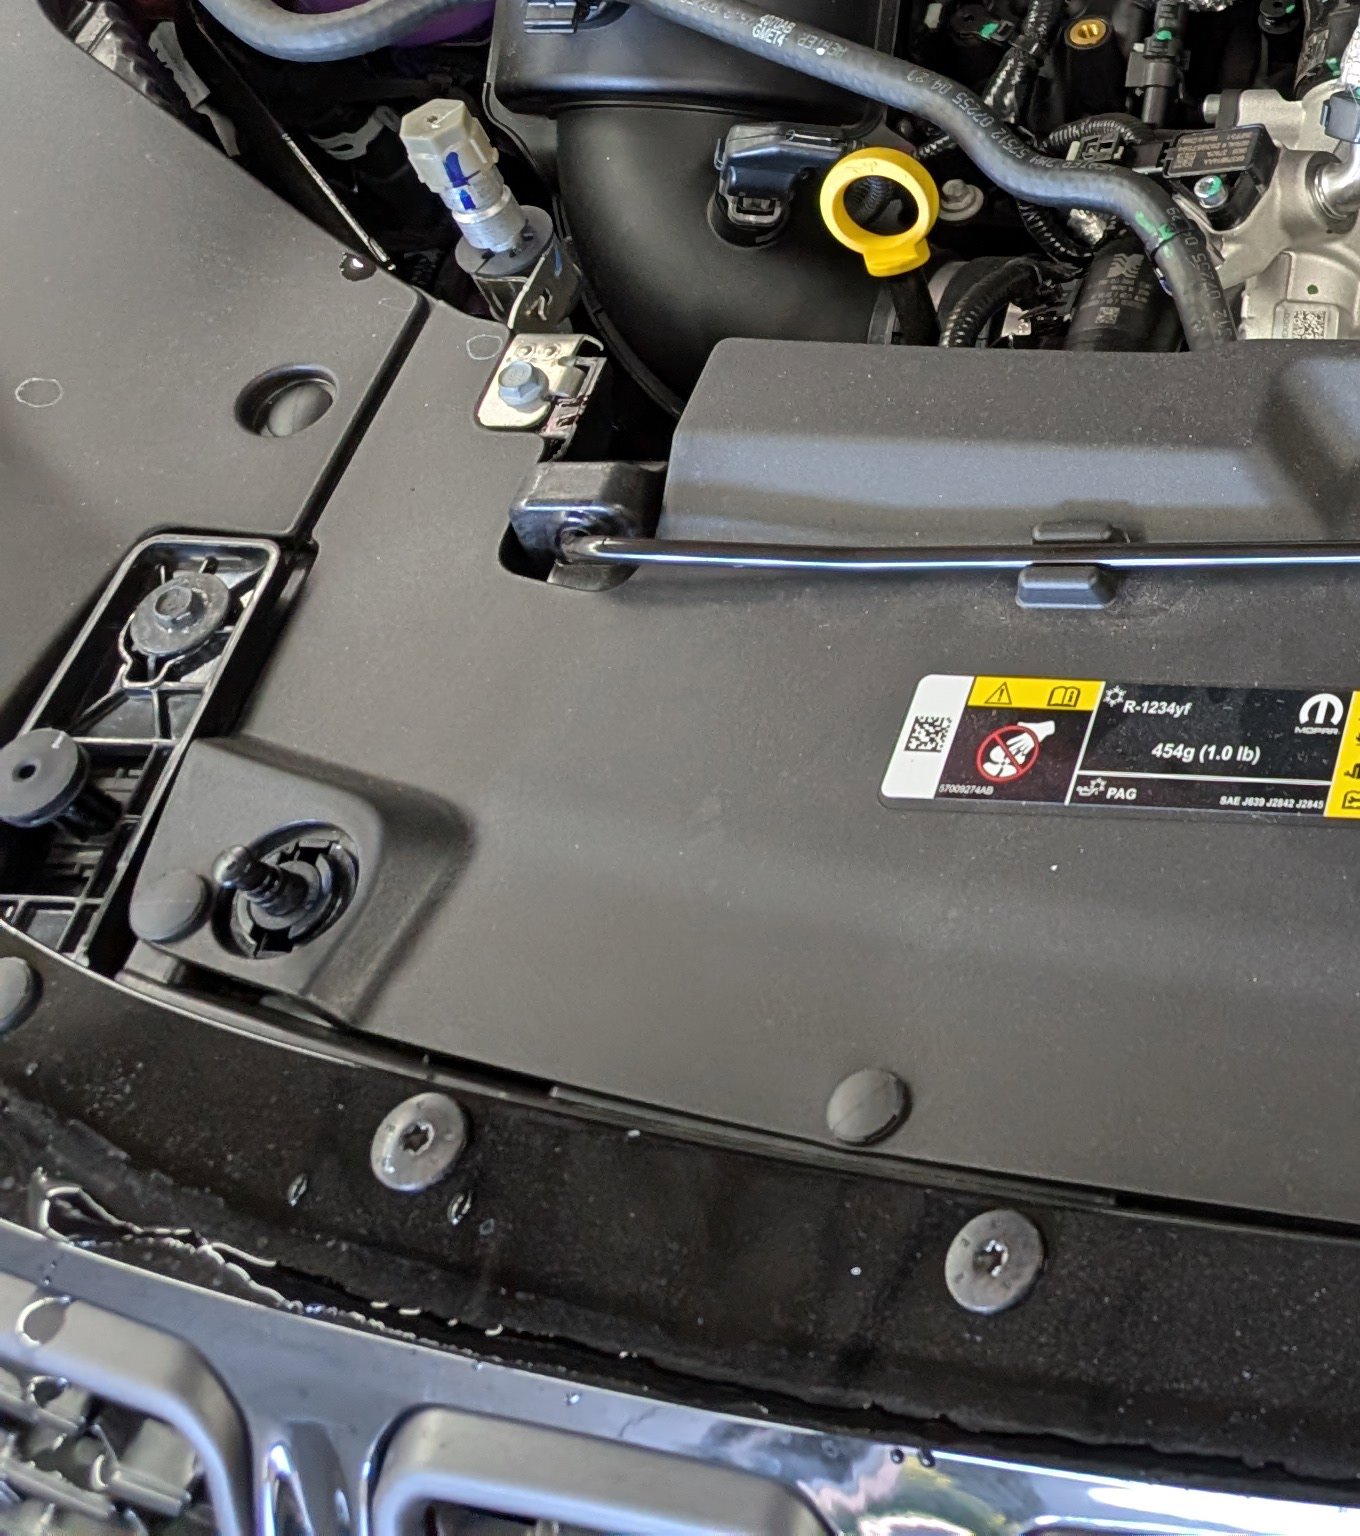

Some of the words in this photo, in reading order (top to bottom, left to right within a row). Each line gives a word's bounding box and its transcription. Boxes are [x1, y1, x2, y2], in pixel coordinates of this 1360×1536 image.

[951, 93, 994, 128] 07255
[991, 128, 1028, 160] 57512
[1122, 699, 1192, 718] R-1234yf
[1294, 726, 1339, 736] MOPAR
[1151, 742, 1195, 763] 454g
[1199, 745, 1233, 764] (1.0
[1236, 745, 1261, 764] lb)
[1106, 786, 1137, 801] PAG
[1219, 795, 1241, 806] SAE
[1242, 796, 1265, 807] J639
